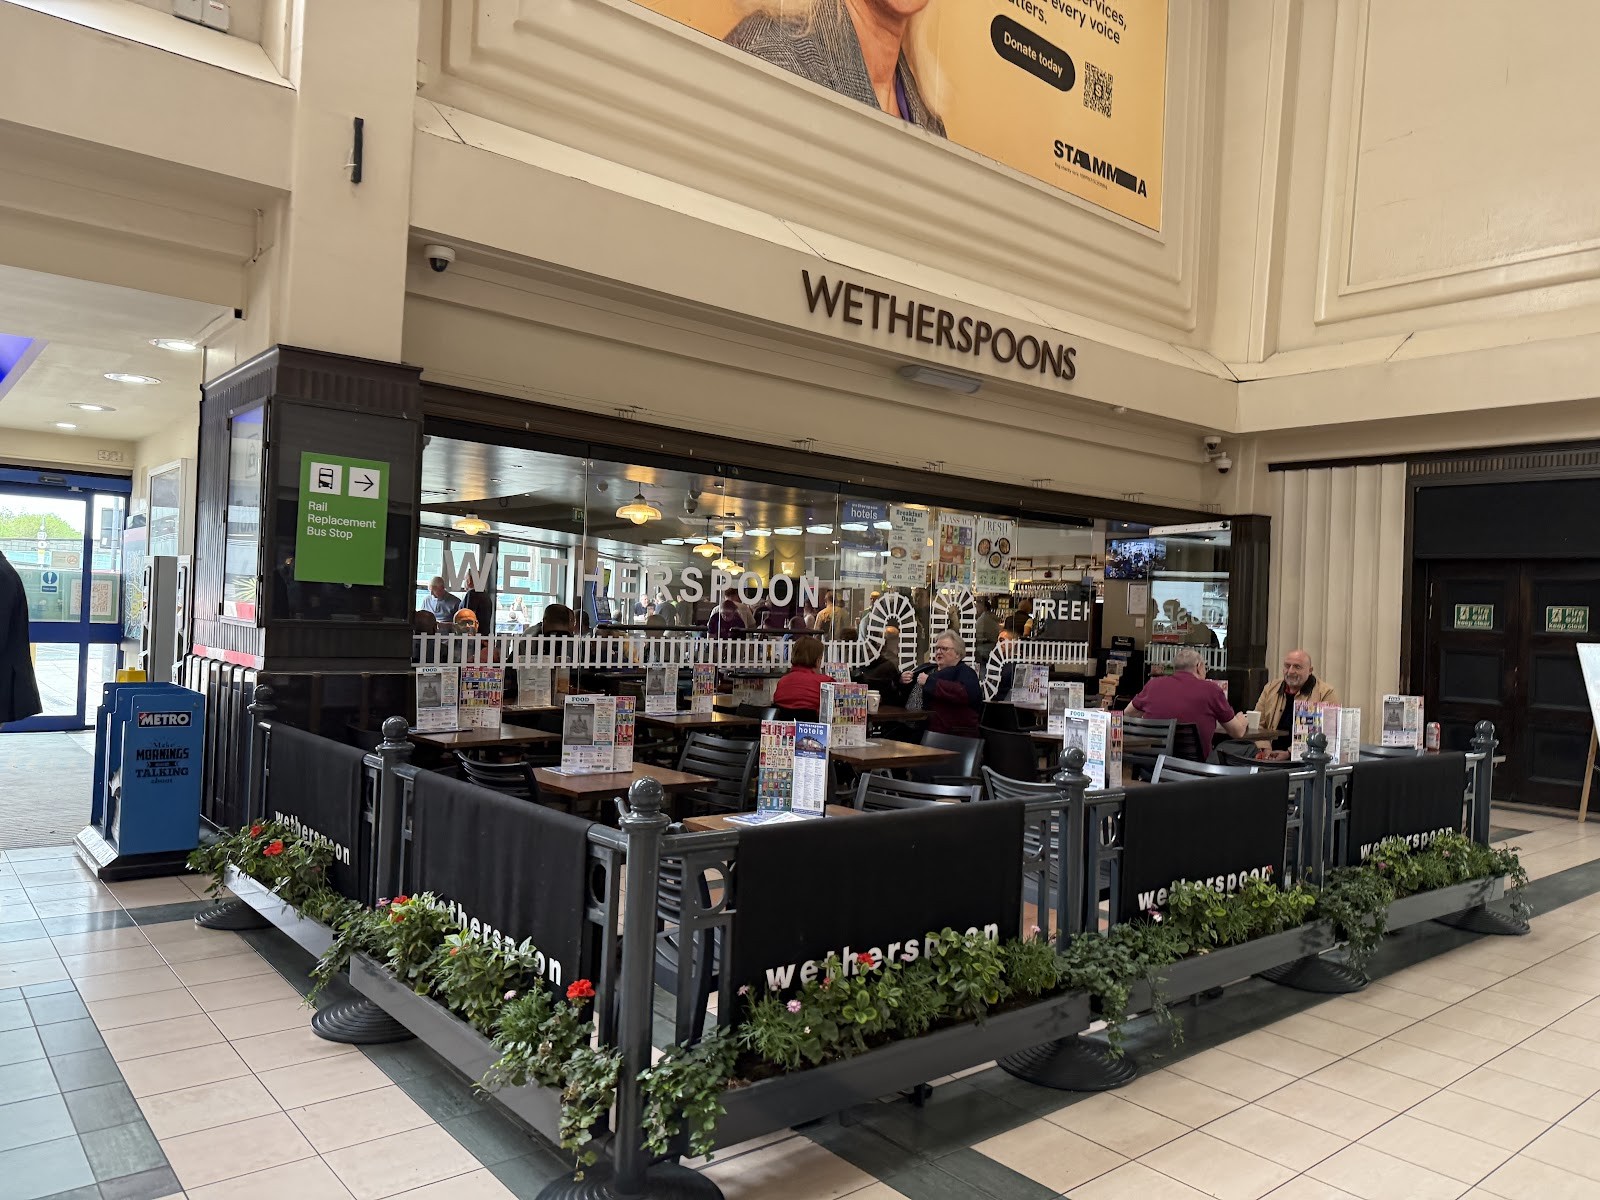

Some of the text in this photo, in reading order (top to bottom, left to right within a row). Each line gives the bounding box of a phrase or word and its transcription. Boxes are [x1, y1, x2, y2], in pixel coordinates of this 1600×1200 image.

[1077, 0, 1127, 31] ervices,
[1051, 0, 1121, 45] every voice
[1003, 31, 1063, 79] Donate today
[801, 269, 1077, 381] WETHERSPOONS
[308, 500, 328, 512] Rail
[851, 507, 878, 520] hotels
[896, 509, 923, 518] Breakfast
[307, 513, 377, 529] Replacement
[983, 520, 1008, 532] FRESH
[306, 526, 353, 541] Bus Stop
[443, 549, 820, 609] WETHERSPOON
[1472, 606, 1490, 615] Fire
[1472, 613, 1488, 621] exit
[1565, 607, 1585, 617] Fire
[1565, 615, 1583, 623] exit
[140, 713, 190, 726] METRO
[798, 725, 824, 736] hotels
[136, 747, 190, 761] MORNINGS
[135, 767, 189, 778] TALKING
